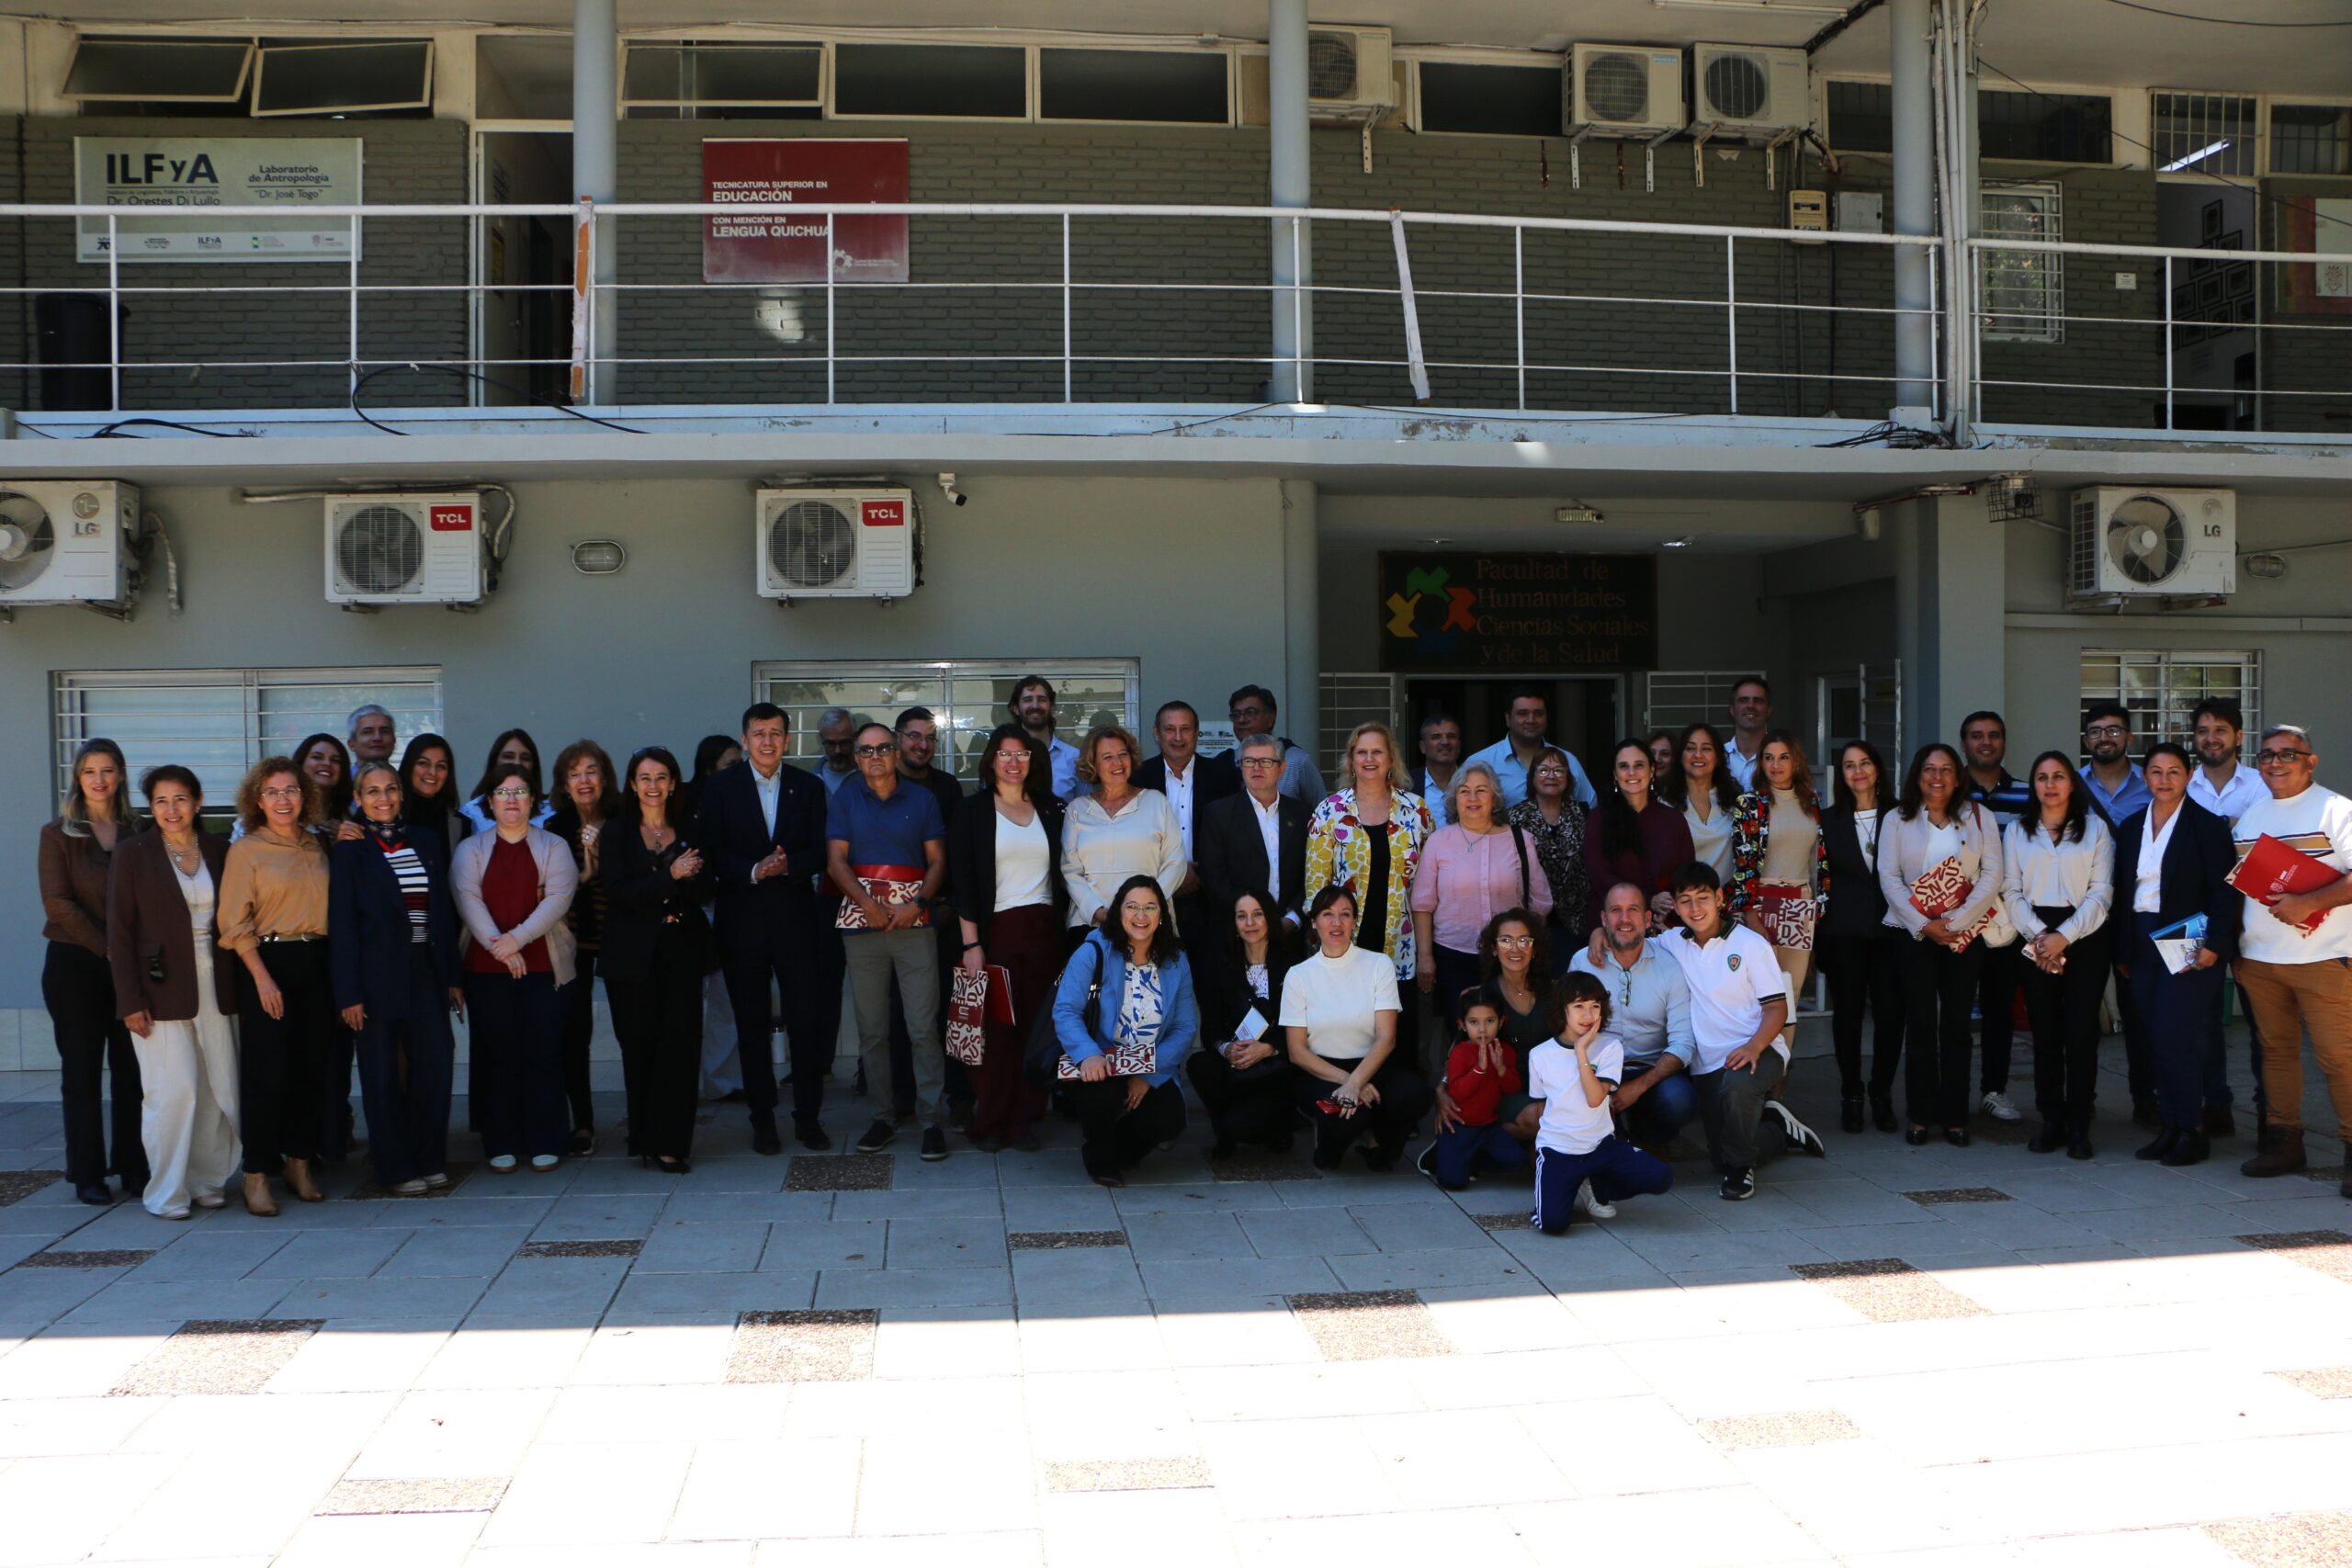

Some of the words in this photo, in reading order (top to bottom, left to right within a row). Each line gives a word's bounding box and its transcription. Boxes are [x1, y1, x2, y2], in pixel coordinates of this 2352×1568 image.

[107, 153, 220, 184] ILFyA
[259, 164, 319, 174] Laboratorio
[248, 174, 261, 182] de
[128, 196, 174, 206] Orestes
[176, 196, 190, 206] Di
[193, 196, 220, 206] Lullo
[713, 188, 792, 202] EDUCACIÓN
[733, 215, 772, 224] MENCIÓN
[713, 226, 767, 237] LENGUA
[435, 513, 467, 524] TCL
[867, 509, 899, 519] TCL
[74, 523, 100, 536] LG
[2204, 525, 2222, 537] LG
[1476, 558, 1570, 581] Facultad
[1582, 559, 1610, 581] de
[1477, 588, 1626, 608] Humanidades
[1476, 614, 1564, 637] Ciencias
[1566, 614, 1649, 637] Sociales
[1532, 642, 1551, 663] la
[1558, 642, 1620, 663] Salud
